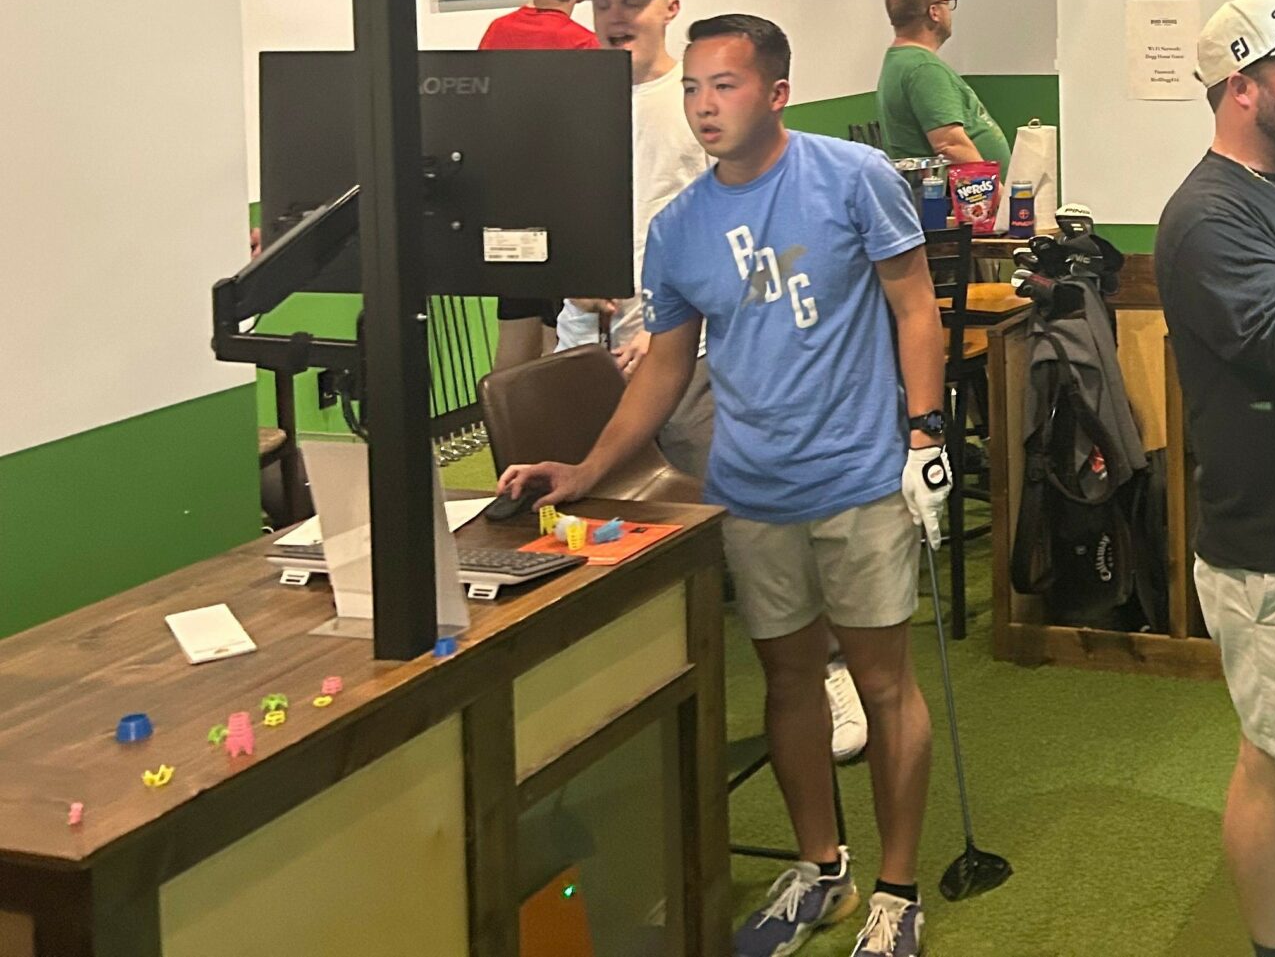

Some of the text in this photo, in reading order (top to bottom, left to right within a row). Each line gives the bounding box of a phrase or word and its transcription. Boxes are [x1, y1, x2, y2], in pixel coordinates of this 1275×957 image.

[1230, 36, 1250, 62] FJ
[423, 76, 491, 95] OPEN
[1064, 207, 1091, 215] PING
